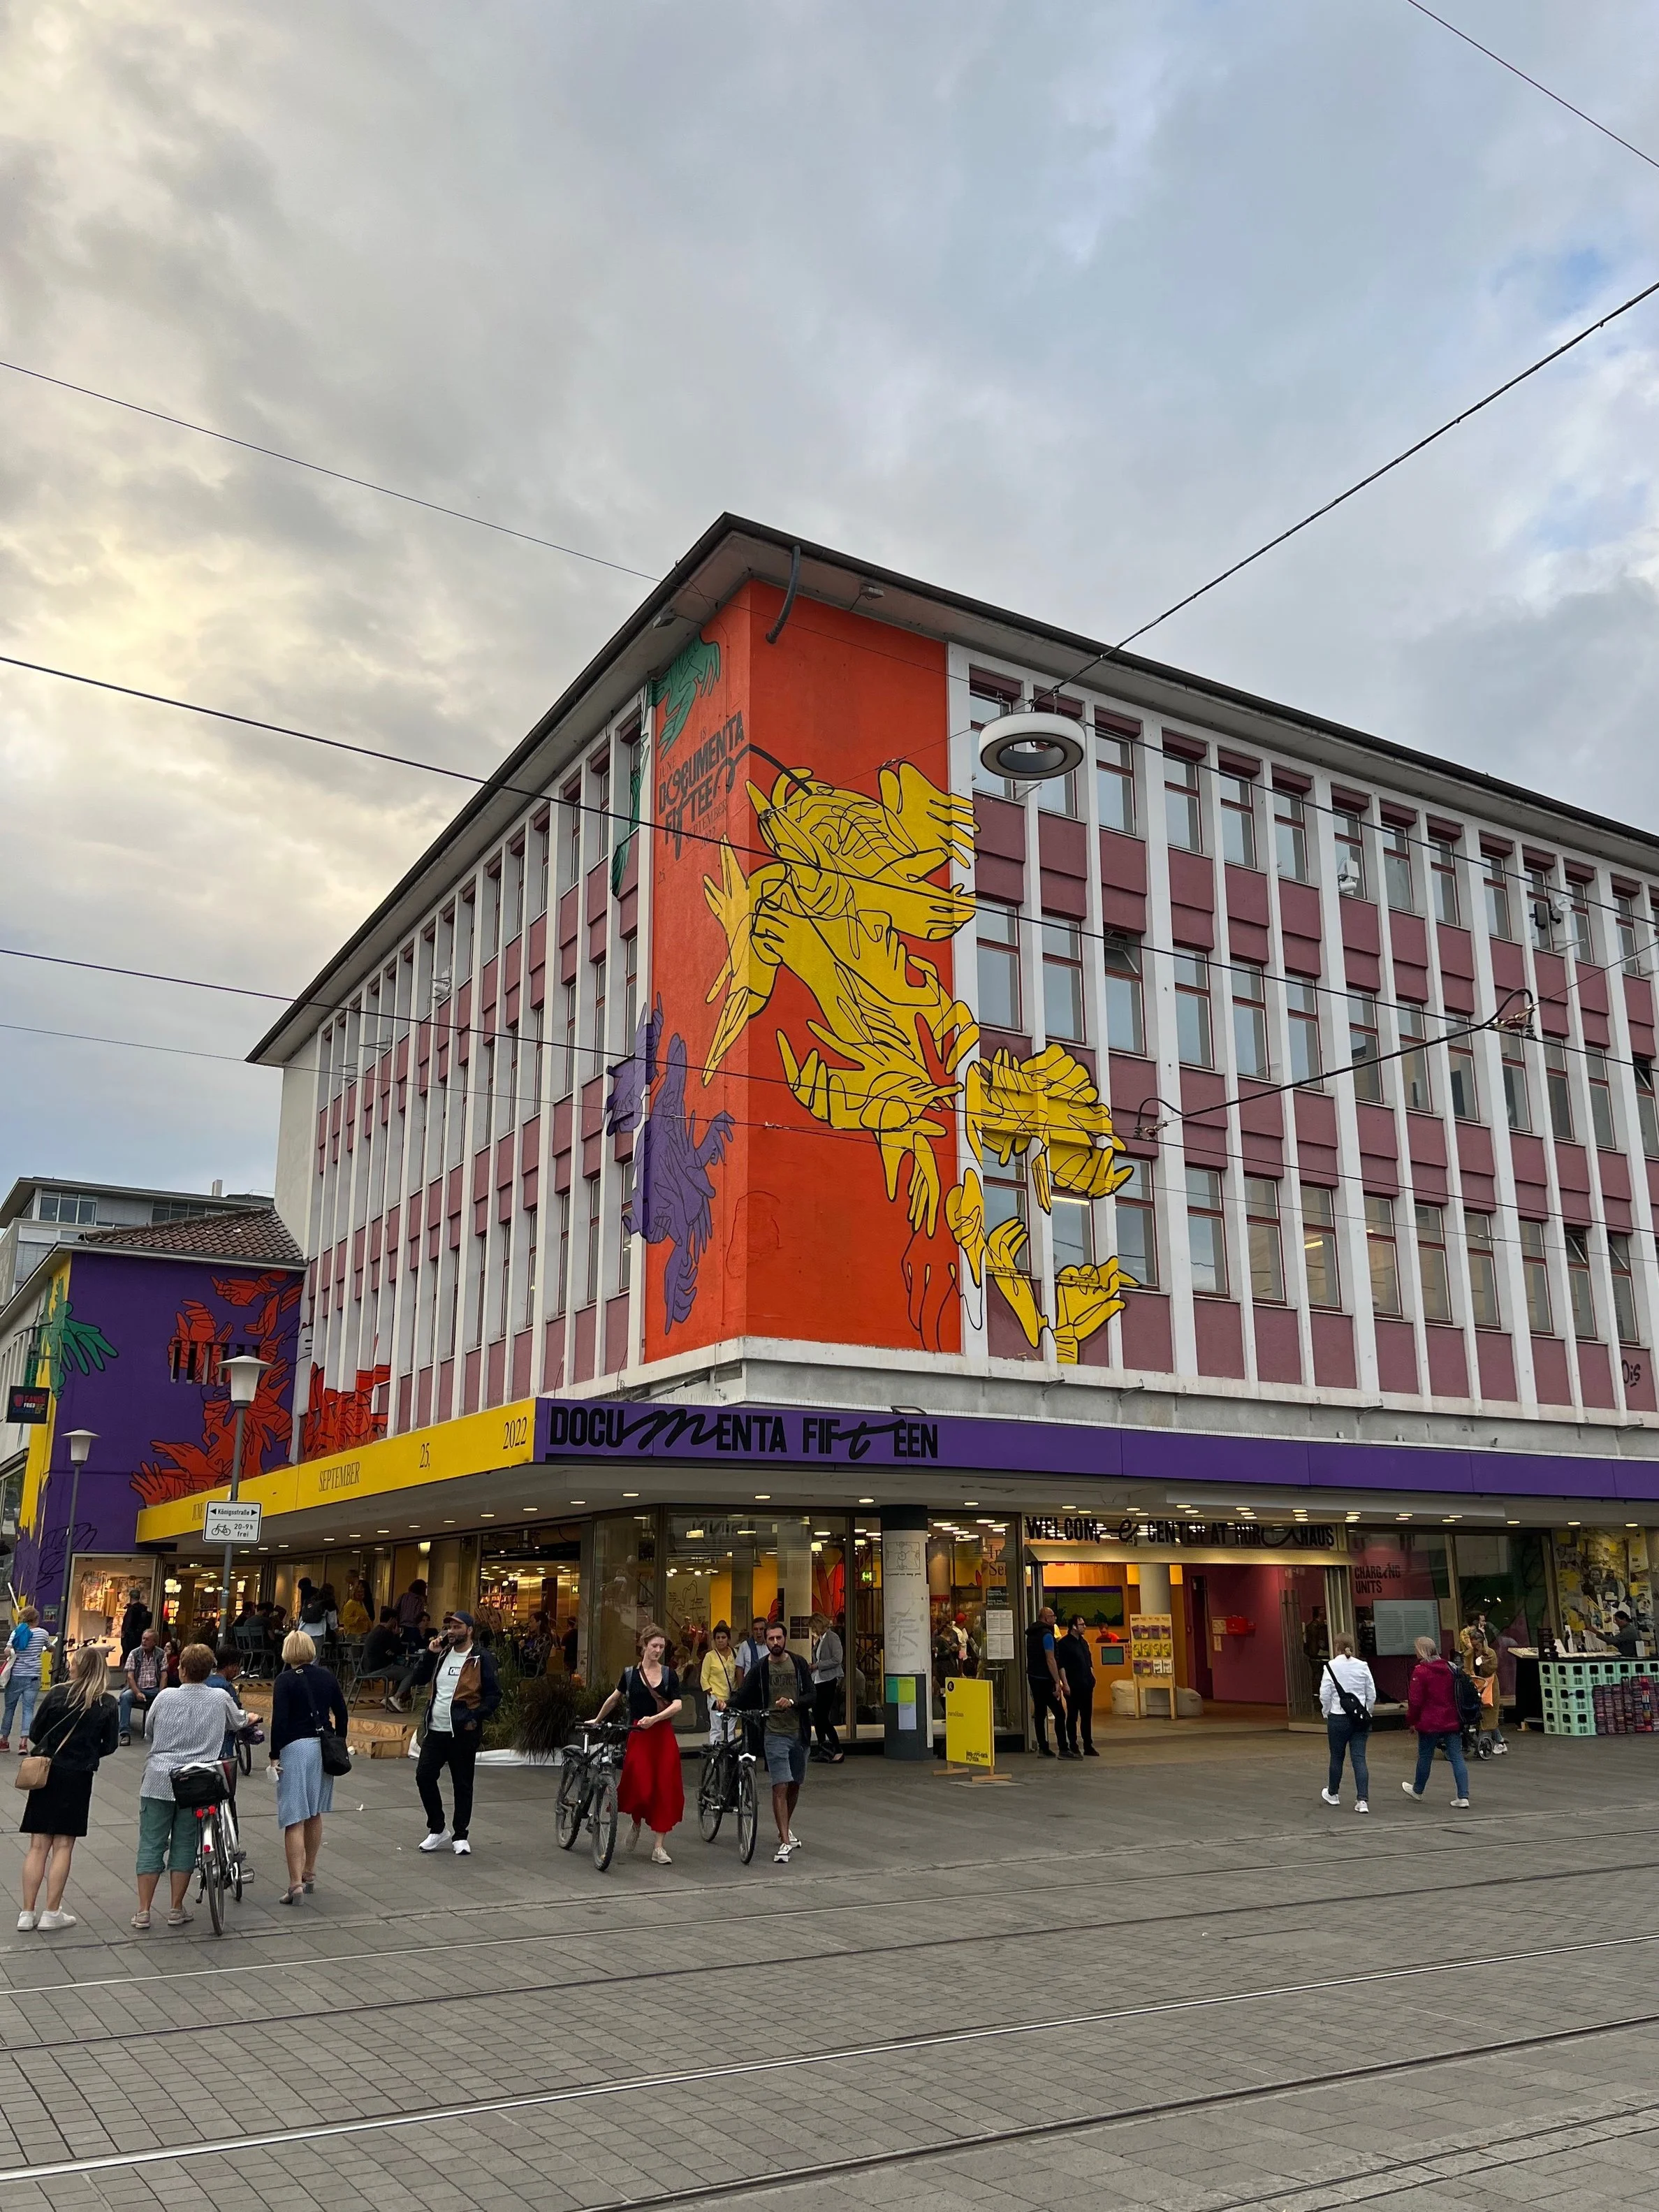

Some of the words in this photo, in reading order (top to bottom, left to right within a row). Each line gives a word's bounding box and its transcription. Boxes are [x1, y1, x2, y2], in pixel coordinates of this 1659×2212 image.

[319, 1461, 360, 1492] SEPTEMBER
[502, 1416, 528, 1450] 2022
[217, 1508, 250, 1517] Königsstraße
[1355, 1580, 1382, 1594] UNITS
